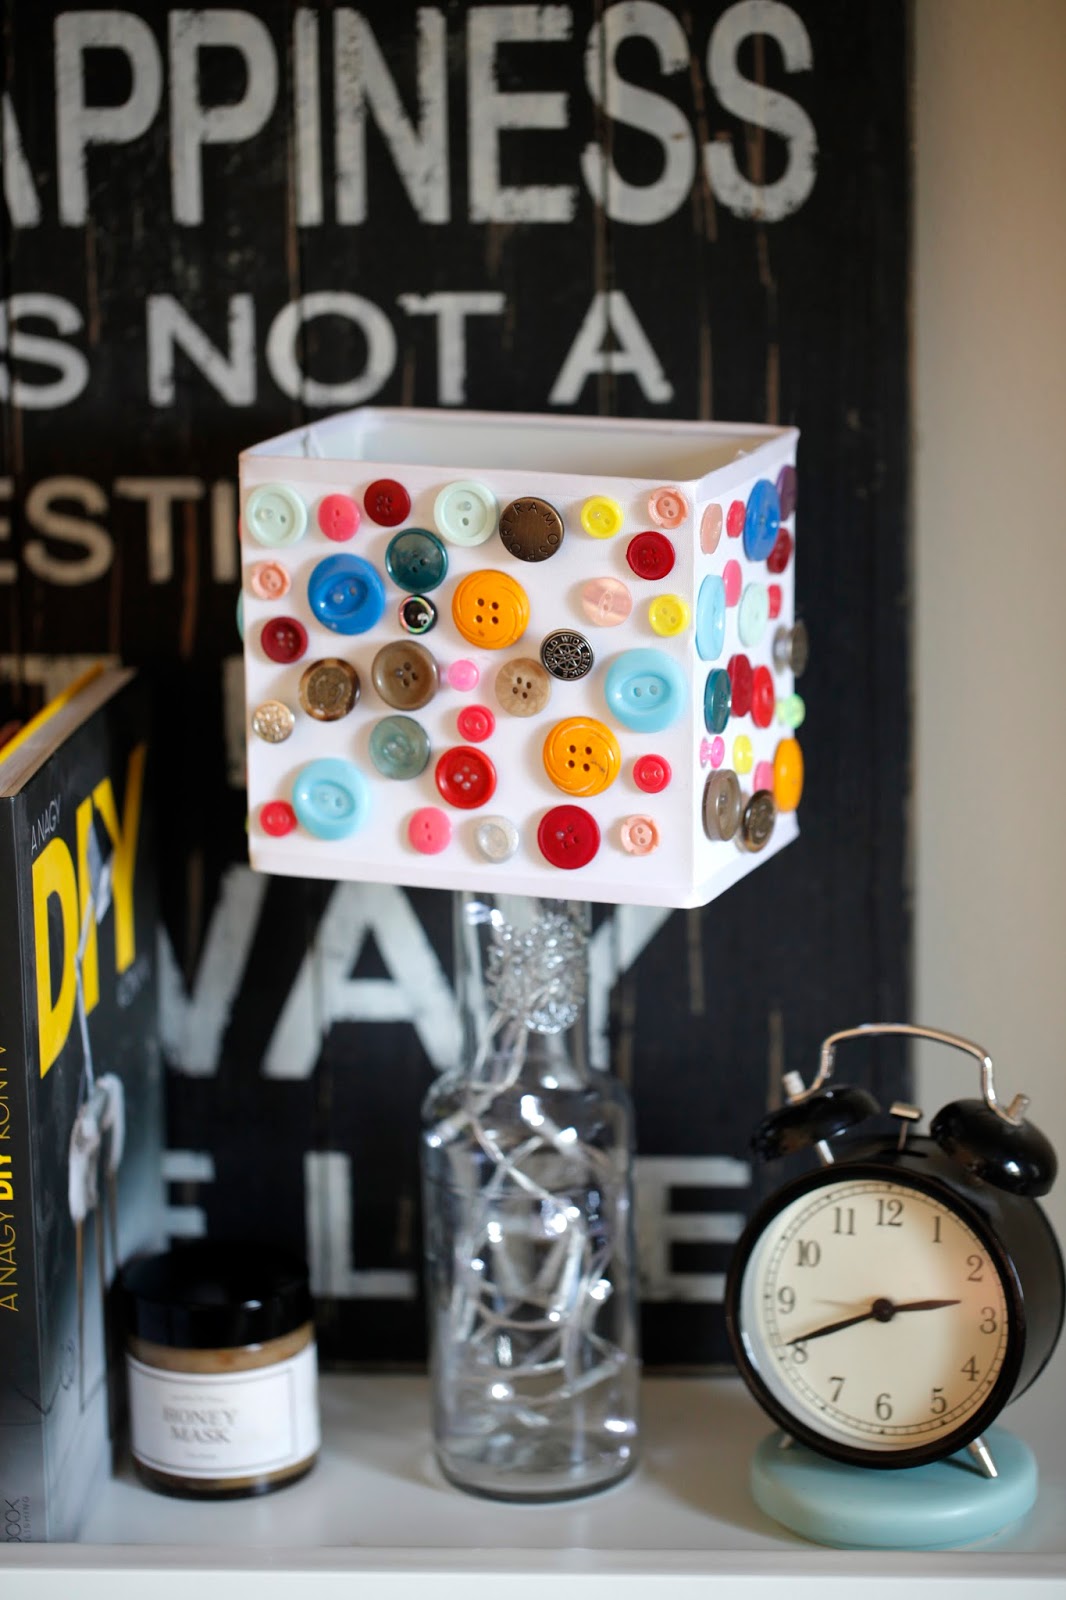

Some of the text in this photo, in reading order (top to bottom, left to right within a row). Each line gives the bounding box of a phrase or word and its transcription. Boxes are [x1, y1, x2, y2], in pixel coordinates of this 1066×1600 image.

[147, 291, 506, 409] NOT
[549, 291, 675, 405] A
[0, 475, 237, 586] STI
[560, 635, 586, 650] WIDE
[32, 744, 147, 1079] DIY
[832, 1206, 857, 1236] 11
[875, 1198, 904, 1227] 12
[931, 1215, 943, 1244] 1
[796, 1239, 822, 1268] 10
[966, 1254, 984, 1282] 2
[777, 1286, 796, 1314] 9
[979, 1306, 998, 1334] 3
[790, 1333, 809, 1364] 8
[961, 1355, 981, 1382] 4
[828, 1376, 847, 1404] 7
[930, 1387, 949, 1415] 5
[162, 1404, 239, 1426] HONEY
[874, 1393, 893, 1421] 6
[169, 1424, 232, 1444] MASK
